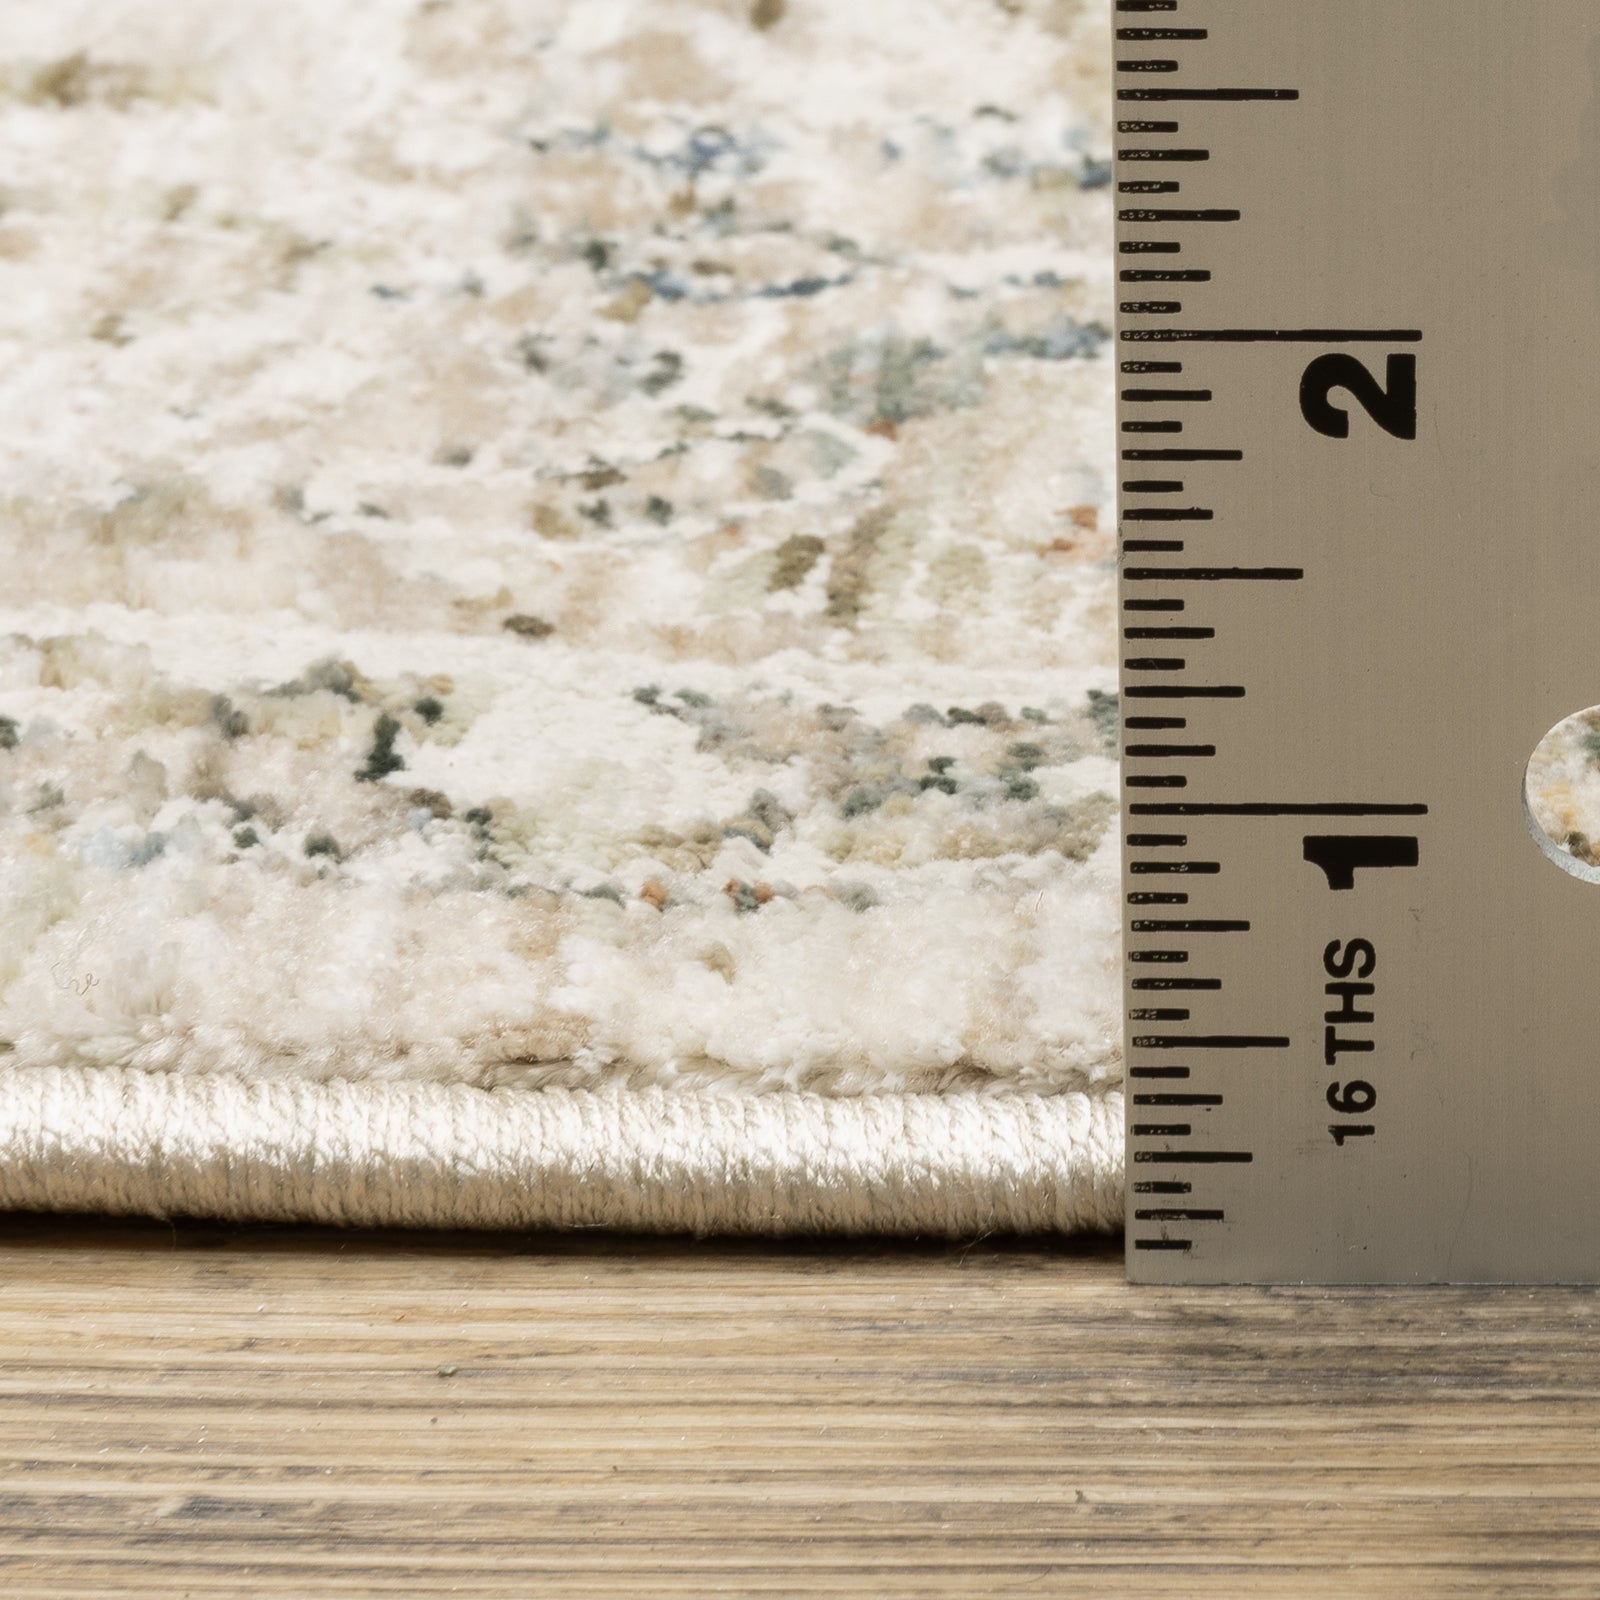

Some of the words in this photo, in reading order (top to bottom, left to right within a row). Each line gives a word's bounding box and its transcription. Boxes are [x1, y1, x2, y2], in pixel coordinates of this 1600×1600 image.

[1300, 352, 1417, 441] 2
[1302, 834, 1420, 891] 1
[1323, 937, 1377, 1066] THS
[1325, 1079, 1377, 1147] 16
